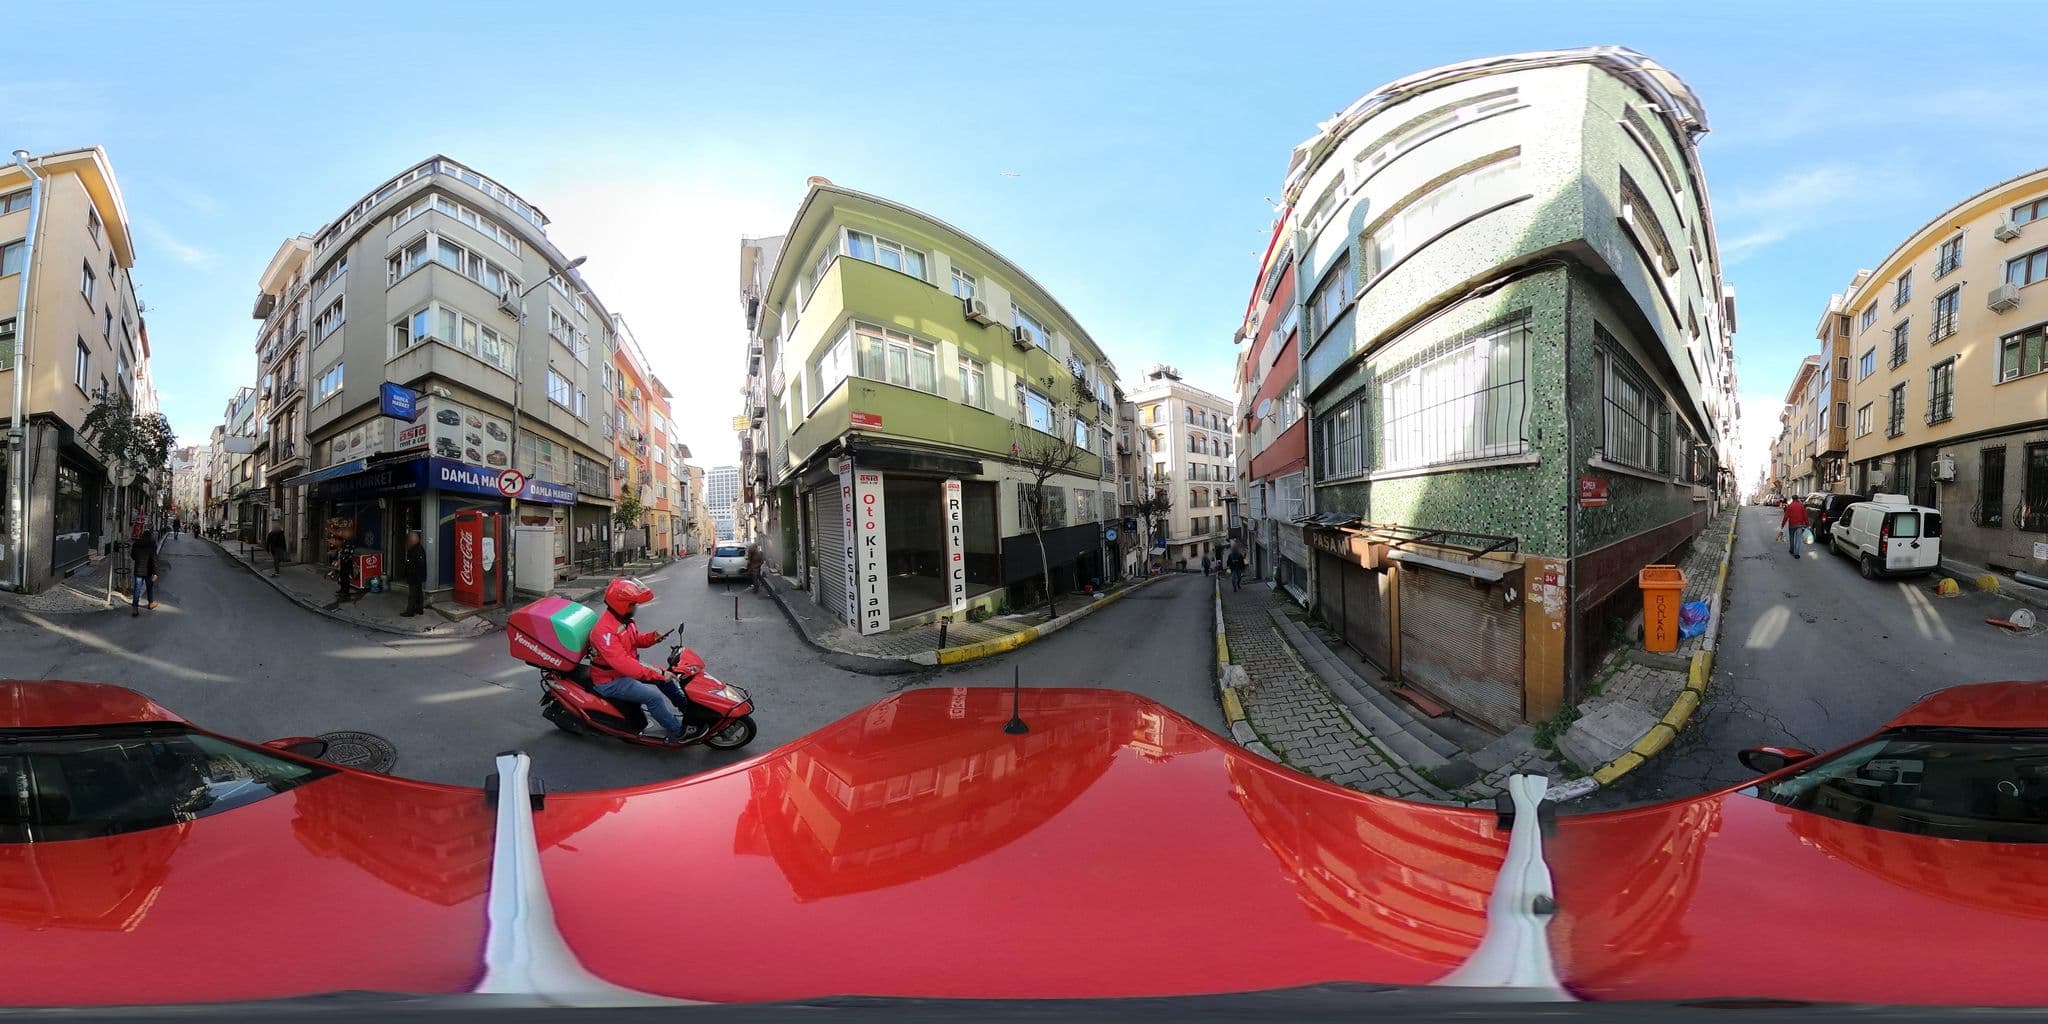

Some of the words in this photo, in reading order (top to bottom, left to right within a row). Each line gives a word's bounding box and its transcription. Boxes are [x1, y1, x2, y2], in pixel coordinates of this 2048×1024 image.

[441, 467, 480, 486] DAMLA
[530, 484, 553, 498] DAMLA
[860, 474, 879, 482] asia
[842, 486, 852, 542] Real
[863, 494, 876, 530] Oto
[949, 499, 960, 547] Rent
[953, 552, 961, 562] a
[865, 535, 881, 629] Kiralama
[953, 568, 963, 606] Car
[514, 632, 563, 668] Yemeksepeti
